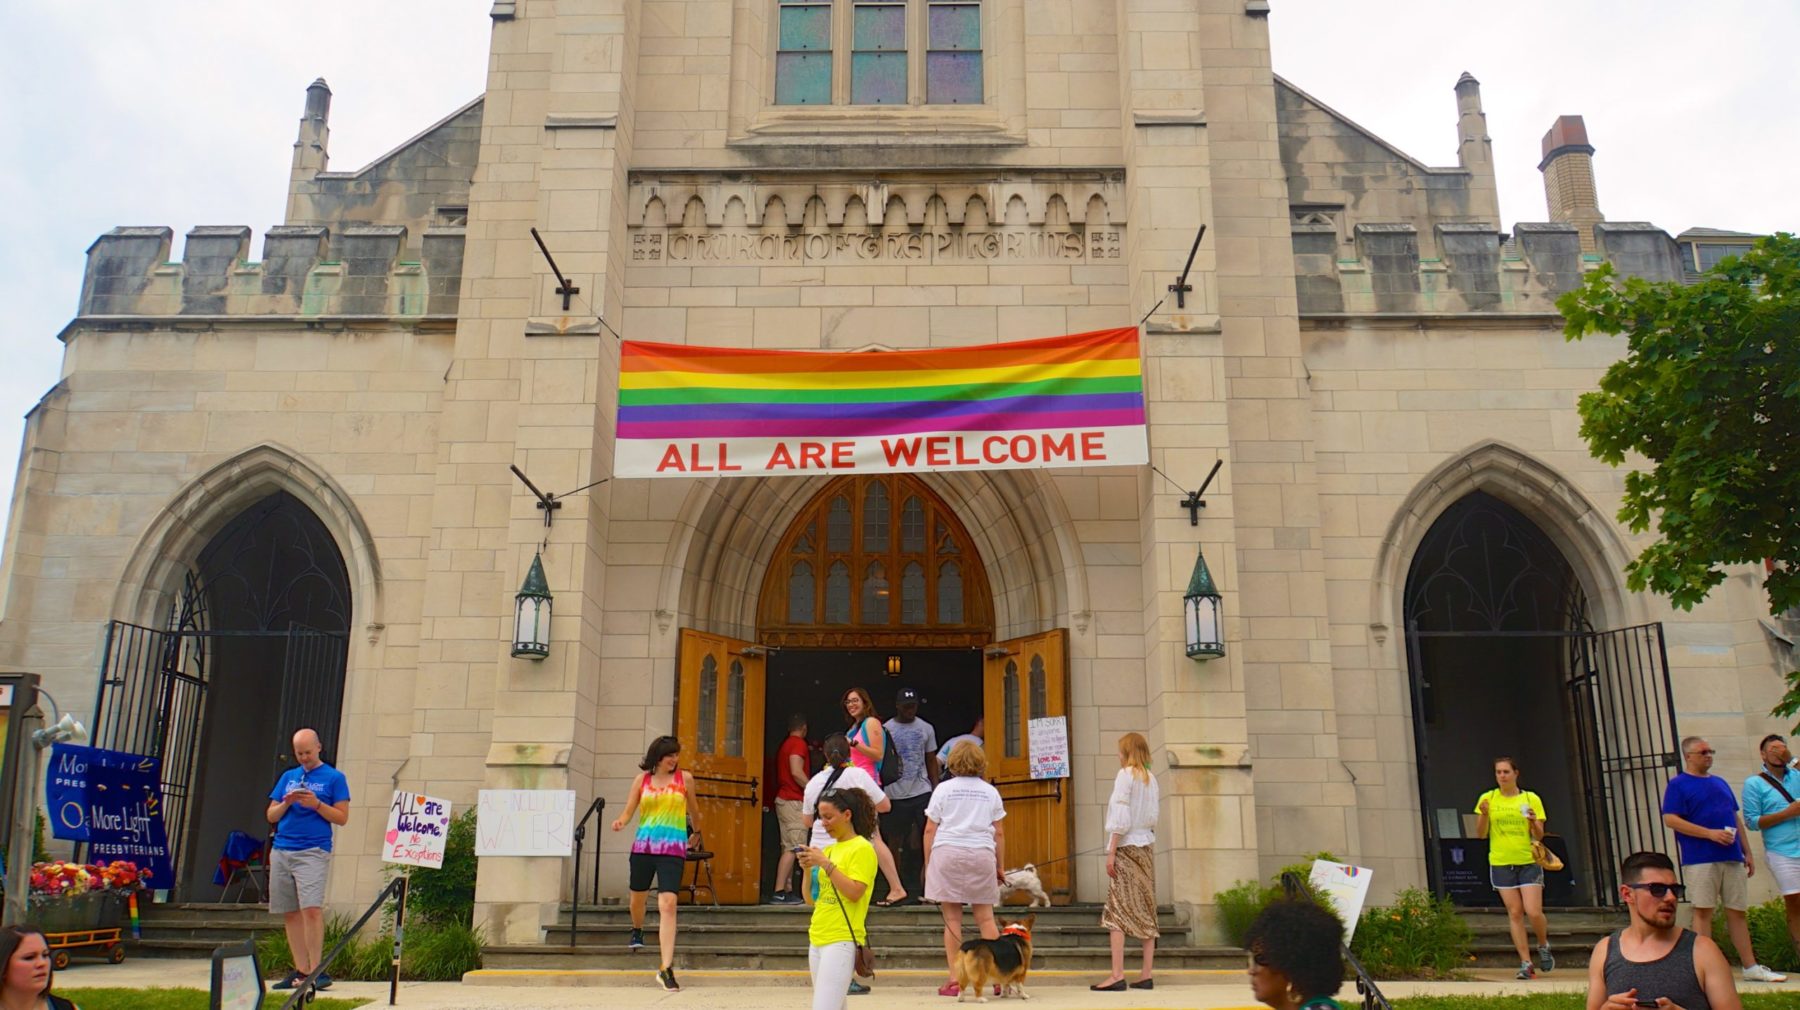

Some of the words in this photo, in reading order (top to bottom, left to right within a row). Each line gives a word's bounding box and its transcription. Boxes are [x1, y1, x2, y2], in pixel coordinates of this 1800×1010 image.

[669, 233, 798, 260] CHURCH
[805, 233, 850, 260] OF
[855, 232, 933, 259] THE
[937, 232, 1084, 259] PILGRIMS
[656, 443, 742, 472] ALL
[765, 441, 856, 470] ARE
[880, 432, 1107, 467] WELCOME
[391, 792, 419, 815] ALL
[424, 801, 443, 815] are
[92, 805, 121, 830] More
[122, 802, 151, 843] Light
[397, 813, 442, 837] Welcome,
[93, 843, 165, 856] PRESBYTERIANS
[410, 834, 422, 844] No
